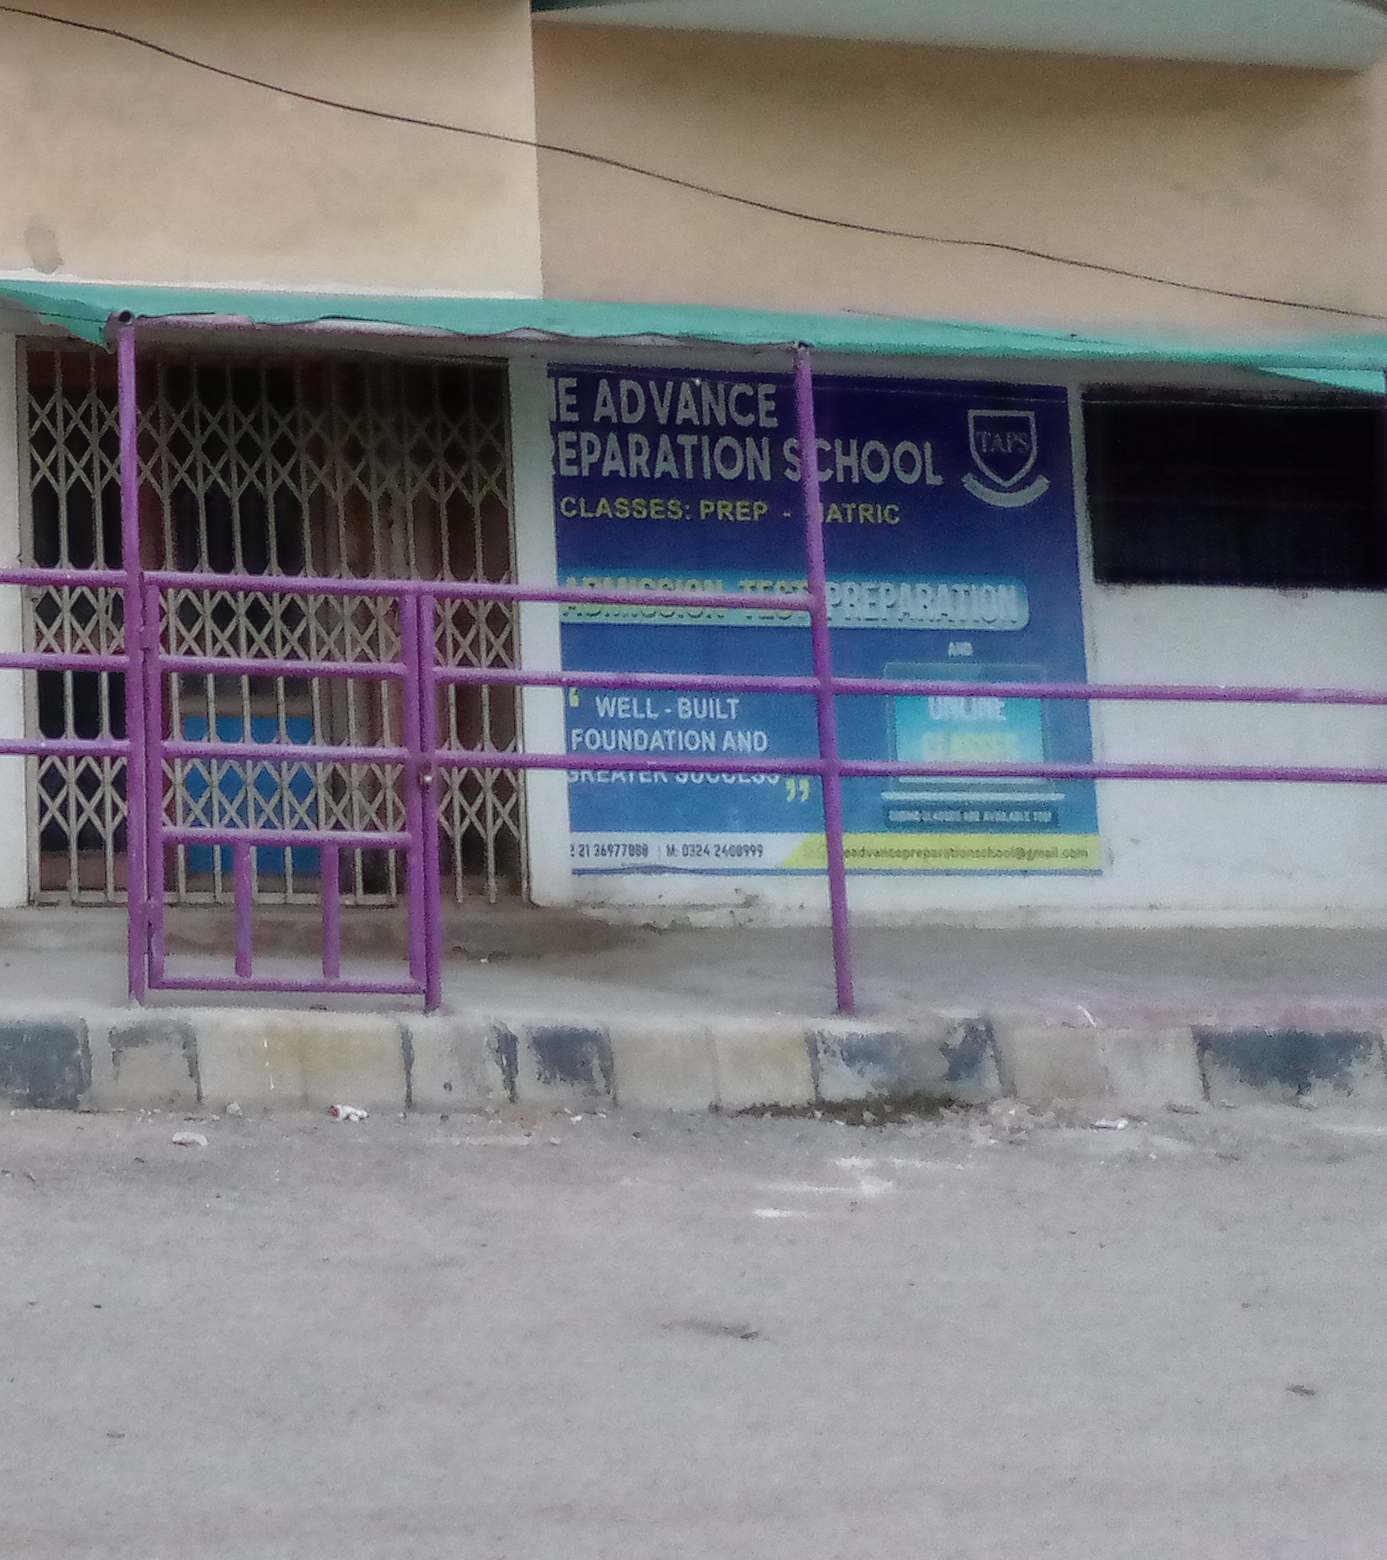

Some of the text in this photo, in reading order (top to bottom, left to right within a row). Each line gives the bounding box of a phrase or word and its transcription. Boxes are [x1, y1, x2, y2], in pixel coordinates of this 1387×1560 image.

[593, 378, 779, 428] ADVANCE
[977, 430, 1029, 454] TAPS
[552, 430, 945, 486] EPARATION SCHOOL
[559, 495, 693, 520] CLASSES:
[699, 498, 769, 521] PREP
[820, 501, 901, 525] ATRIC
[825, 581, 1021, 624] PREPARATION
[595, 695, 659, 720] WELL
[677, 697, 740, 720] BUILT
[570, 728, 769, 752] FOUNDATION AND
